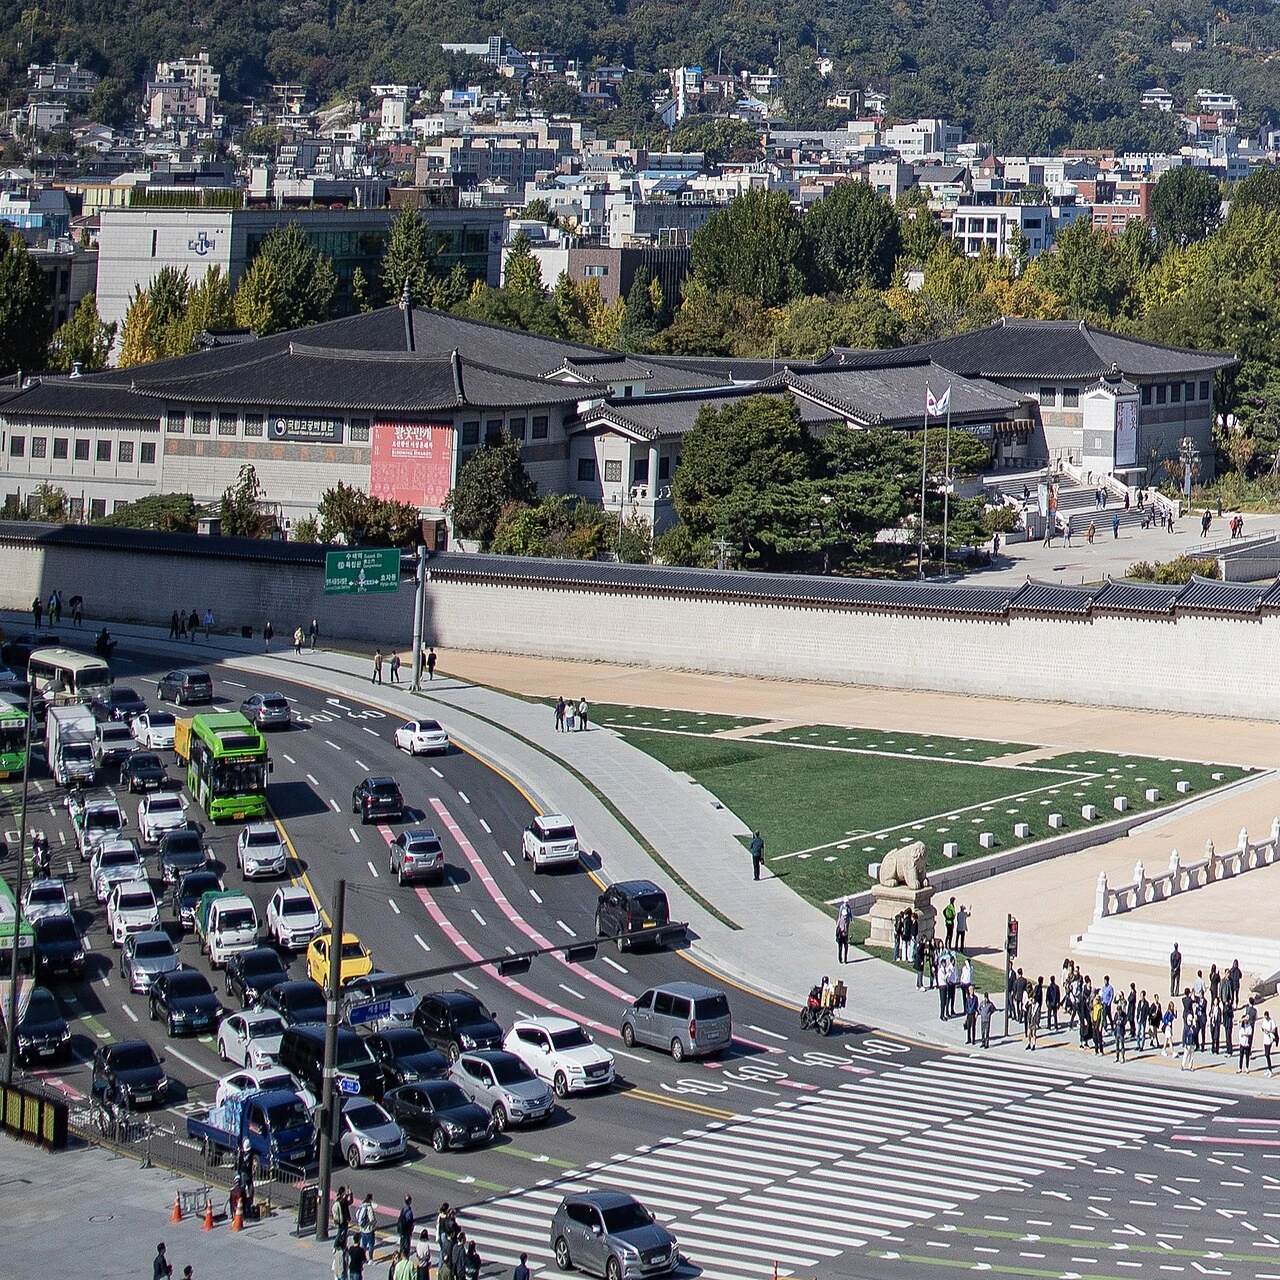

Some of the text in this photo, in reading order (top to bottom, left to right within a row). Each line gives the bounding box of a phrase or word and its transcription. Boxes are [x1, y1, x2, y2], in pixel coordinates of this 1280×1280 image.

[288, 420, 334, 431] 국립고궁박물관
[394, 425, 431, 440] 활옷만개
[844, 1039, 910, 1055] 40
[788, 1052, 854, 1067] 40
[723, 1065, 789, 1082] 40
[660, 1079, 728, 1095] 40
